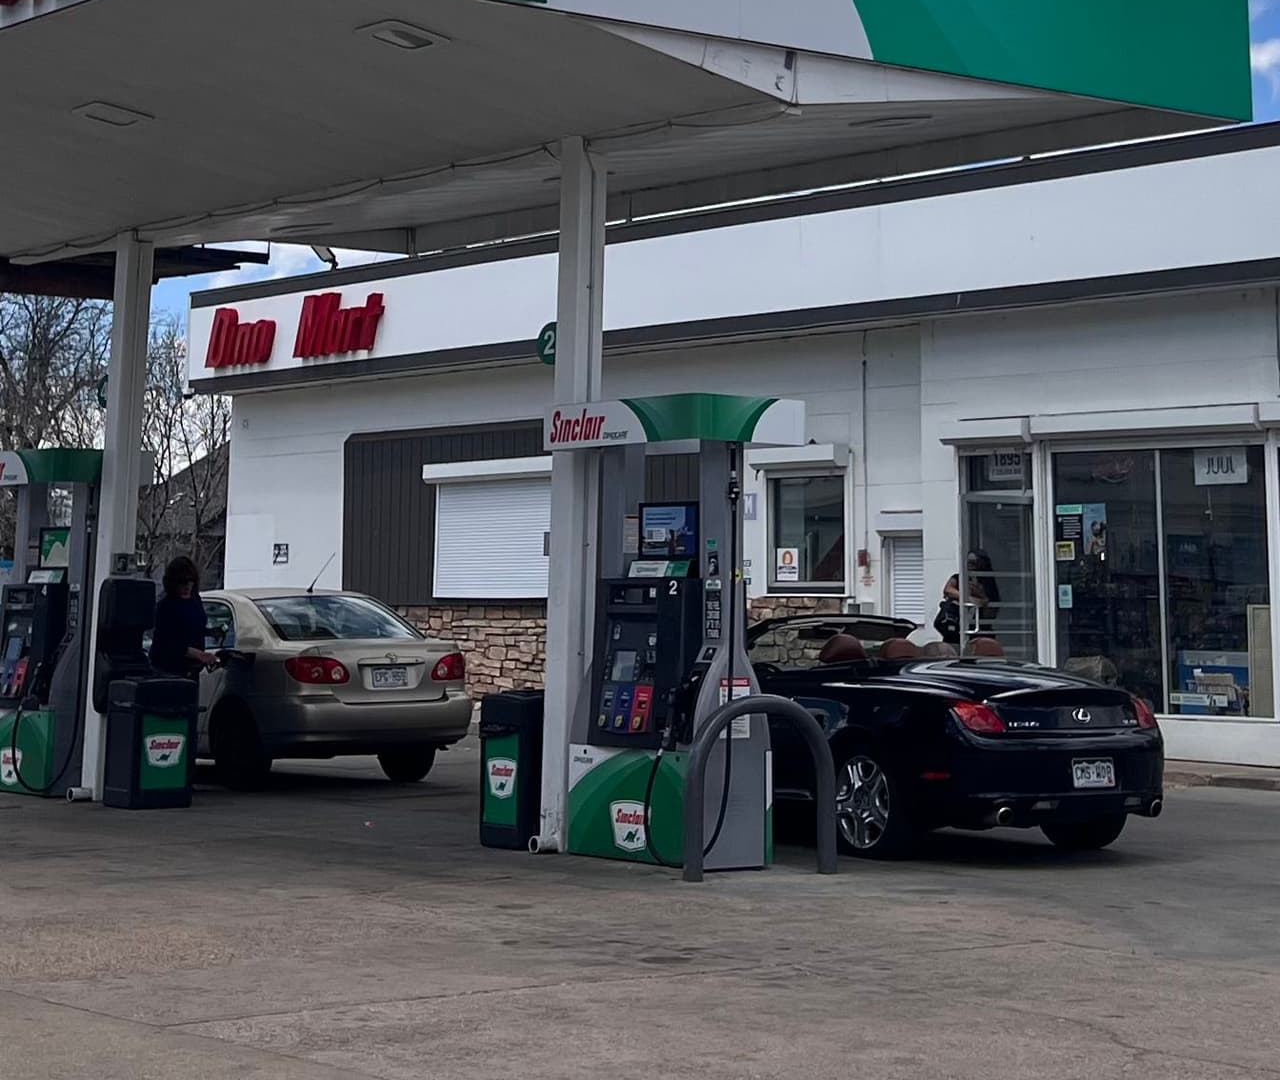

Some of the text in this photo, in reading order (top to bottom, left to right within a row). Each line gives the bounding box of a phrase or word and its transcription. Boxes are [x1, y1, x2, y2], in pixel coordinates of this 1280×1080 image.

[205, 292, 385, 368] Dino Mart
[543, 330, 555, 355] 2
[550, 408, 605, 443] Sinclair
[1206, 455, 1235, 475] JUUL
[669, 580, 678, 595] 2
